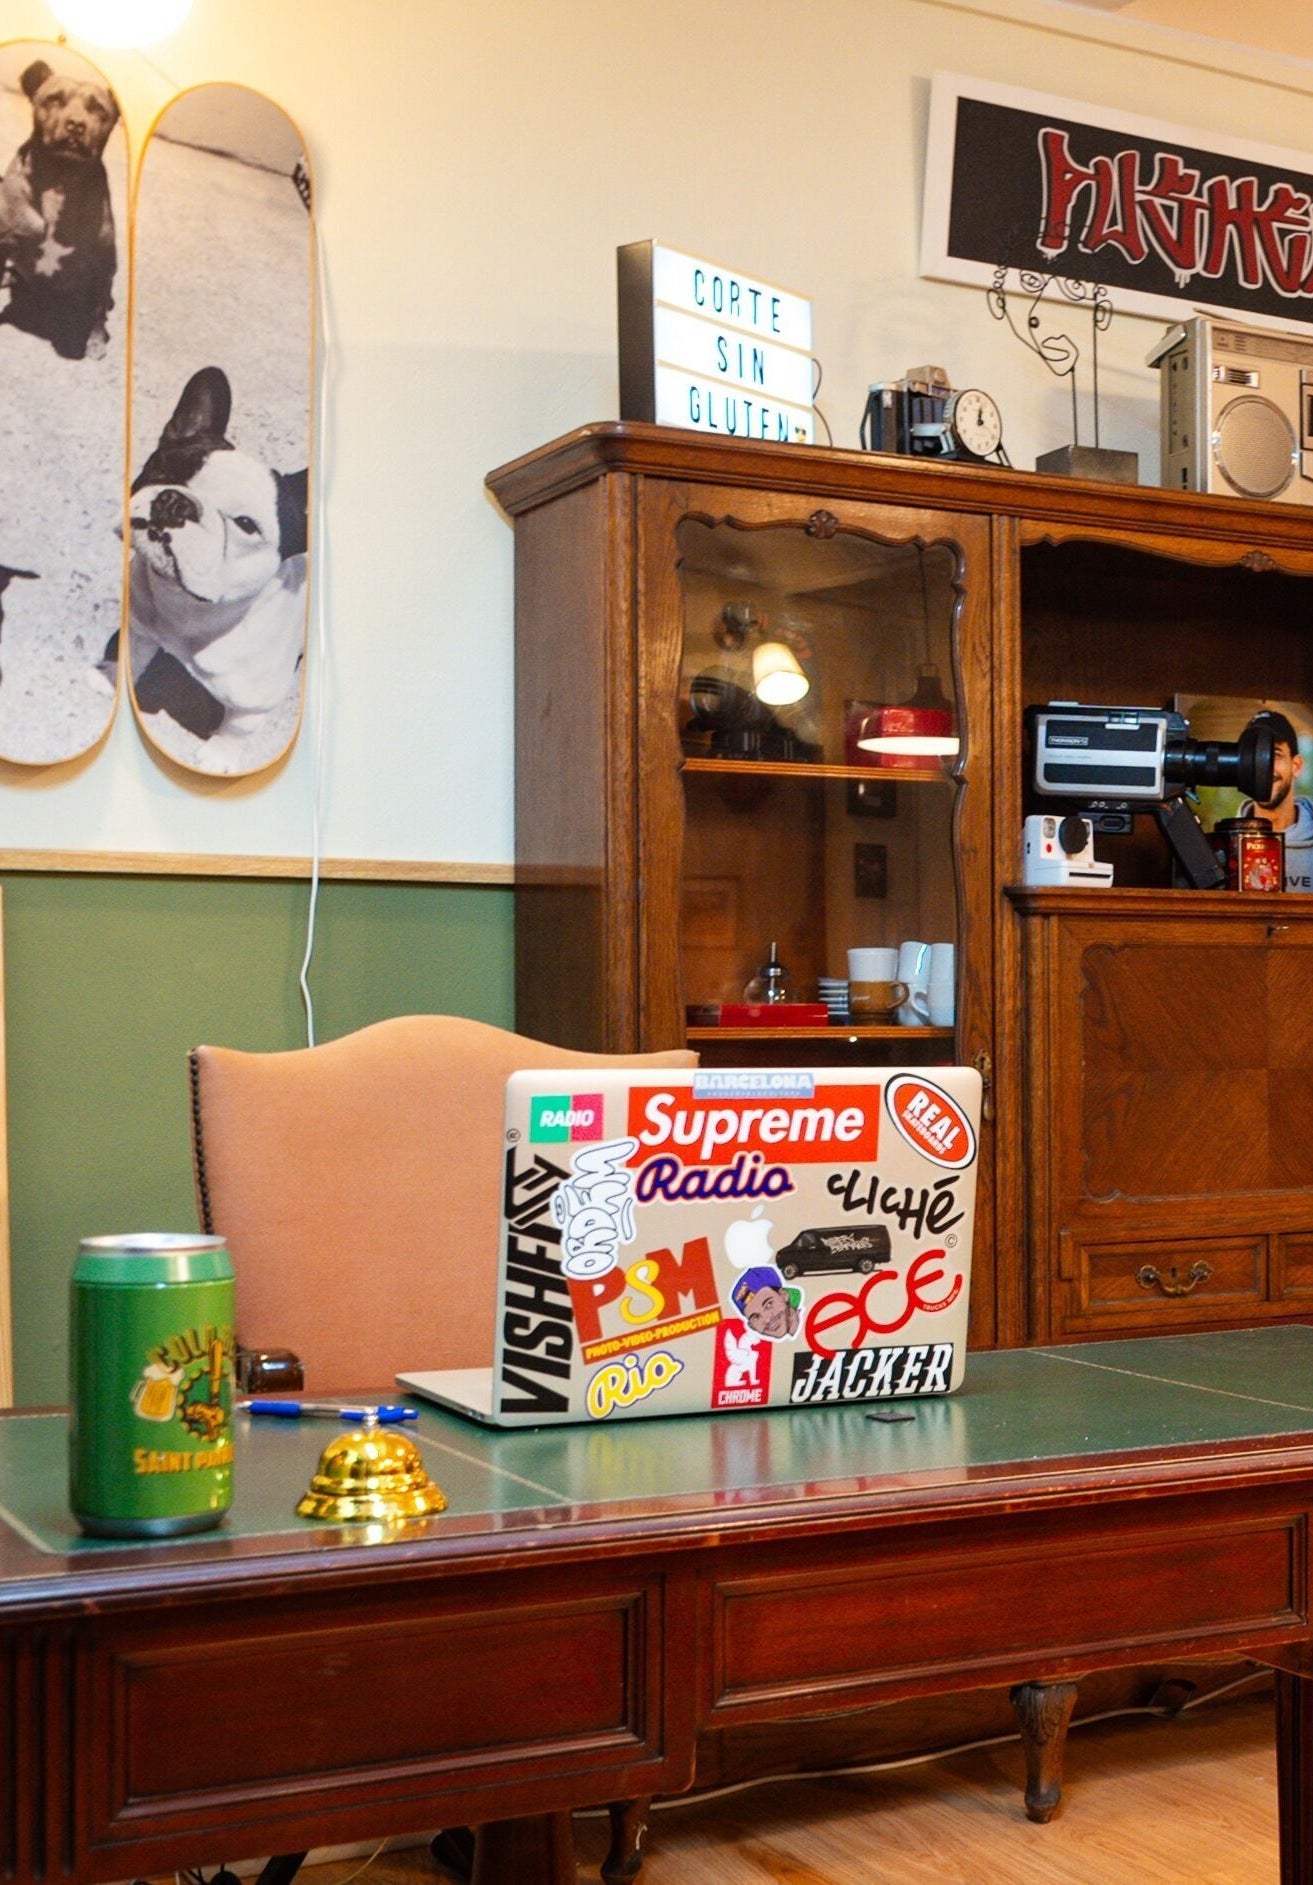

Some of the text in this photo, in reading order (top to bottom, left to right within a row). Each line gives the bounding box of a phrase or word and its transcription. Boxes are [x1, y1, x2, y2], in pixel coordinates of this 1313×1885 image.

[694, 269, 781, 333] CORTE
[717, 336, 764, 385] SIN
[689, 385, 789, 442] GLUTEN
[1284, 876, 1311, 887] VE
[695, 1074, 812, 1089] BARCELONA
[539, 1109, 595, 1128] RADIO
[641, 1094, 865, 1161] Supreme
[906, 1090, 961, 1150] REAL
[637, 1155, 795, 1202] Radio
[567, 1236, 720, 1344] PSM
[587, 1352, 684, 1420] Rio
[717, 1388, 762, 1405] CHROME
[790, 1344, 953, 1404] JACKER
[134, 1448, 192, 1474] SAINT
